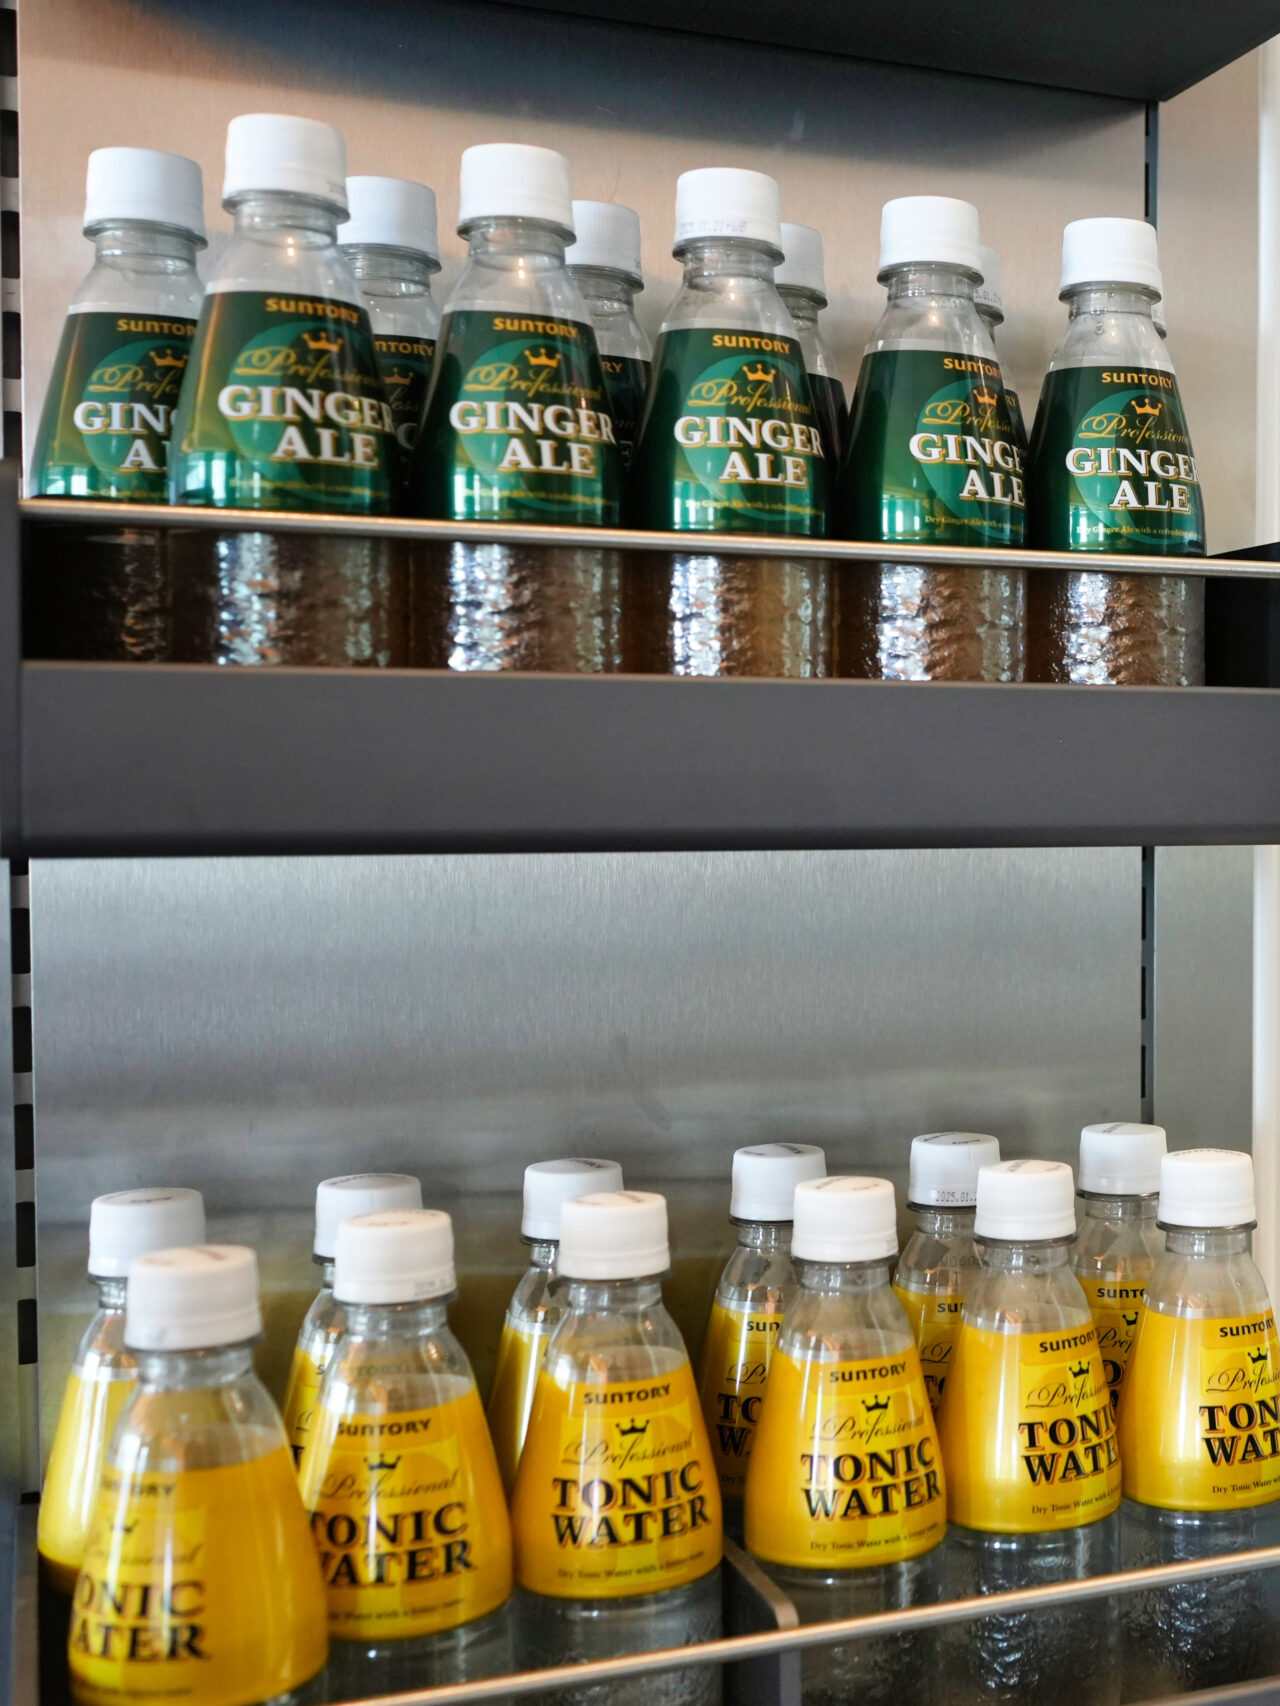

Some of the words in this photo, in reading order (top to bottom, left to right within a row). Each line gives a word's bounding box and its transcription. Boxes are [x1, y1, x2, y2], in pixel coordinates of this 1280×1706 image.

[265, 298, 360, 324] SUNTORY
[493, 317, 578, 338] SUNTORY
[712, 334, 790, 354] SUNTORY
[1101, 372, 1173, 389] SUNTORY
[73, 401, 178, 435] GIN
[217, 384, 397, 434] GINGER
[449, 400, 617, 446] GINGER
[271, 425, 380, 470] ALE
[673, 415, 825, 459] GINGER
[497, 437, 597, 479] ALE
[718, 450, 809, 490] ALE
[959, 468, 1026, 510] ALE
[1109, 479, 1192, 515] ALE
[829, 1361, 907, 1383] SUNTORY
[584, 1383, 672, 1405] SUNTORY
[336, 1418, 432, 1437] SUNTORY
[801, 1436, 936, 1486] TONIC
[552, 1459, 705, 1514] TONIC
[801, 1467, 943, 1522] WATER
[1212, 1485, 1228, 1494] Dry
[1231, 1483, 1252, 1493] Tonic
[552, 1494, 712, 1551] WATER
[1032, 1505, 1047, 1515] Dry
[322, 1539, 479, 1590] ATER
[810, 1541, 827, 1552] Dry
[856, 1539, 881, 1549] Water
[73, 1572, 207, 1618] ONIC
[73, 1616, 213, 1663] ATER
